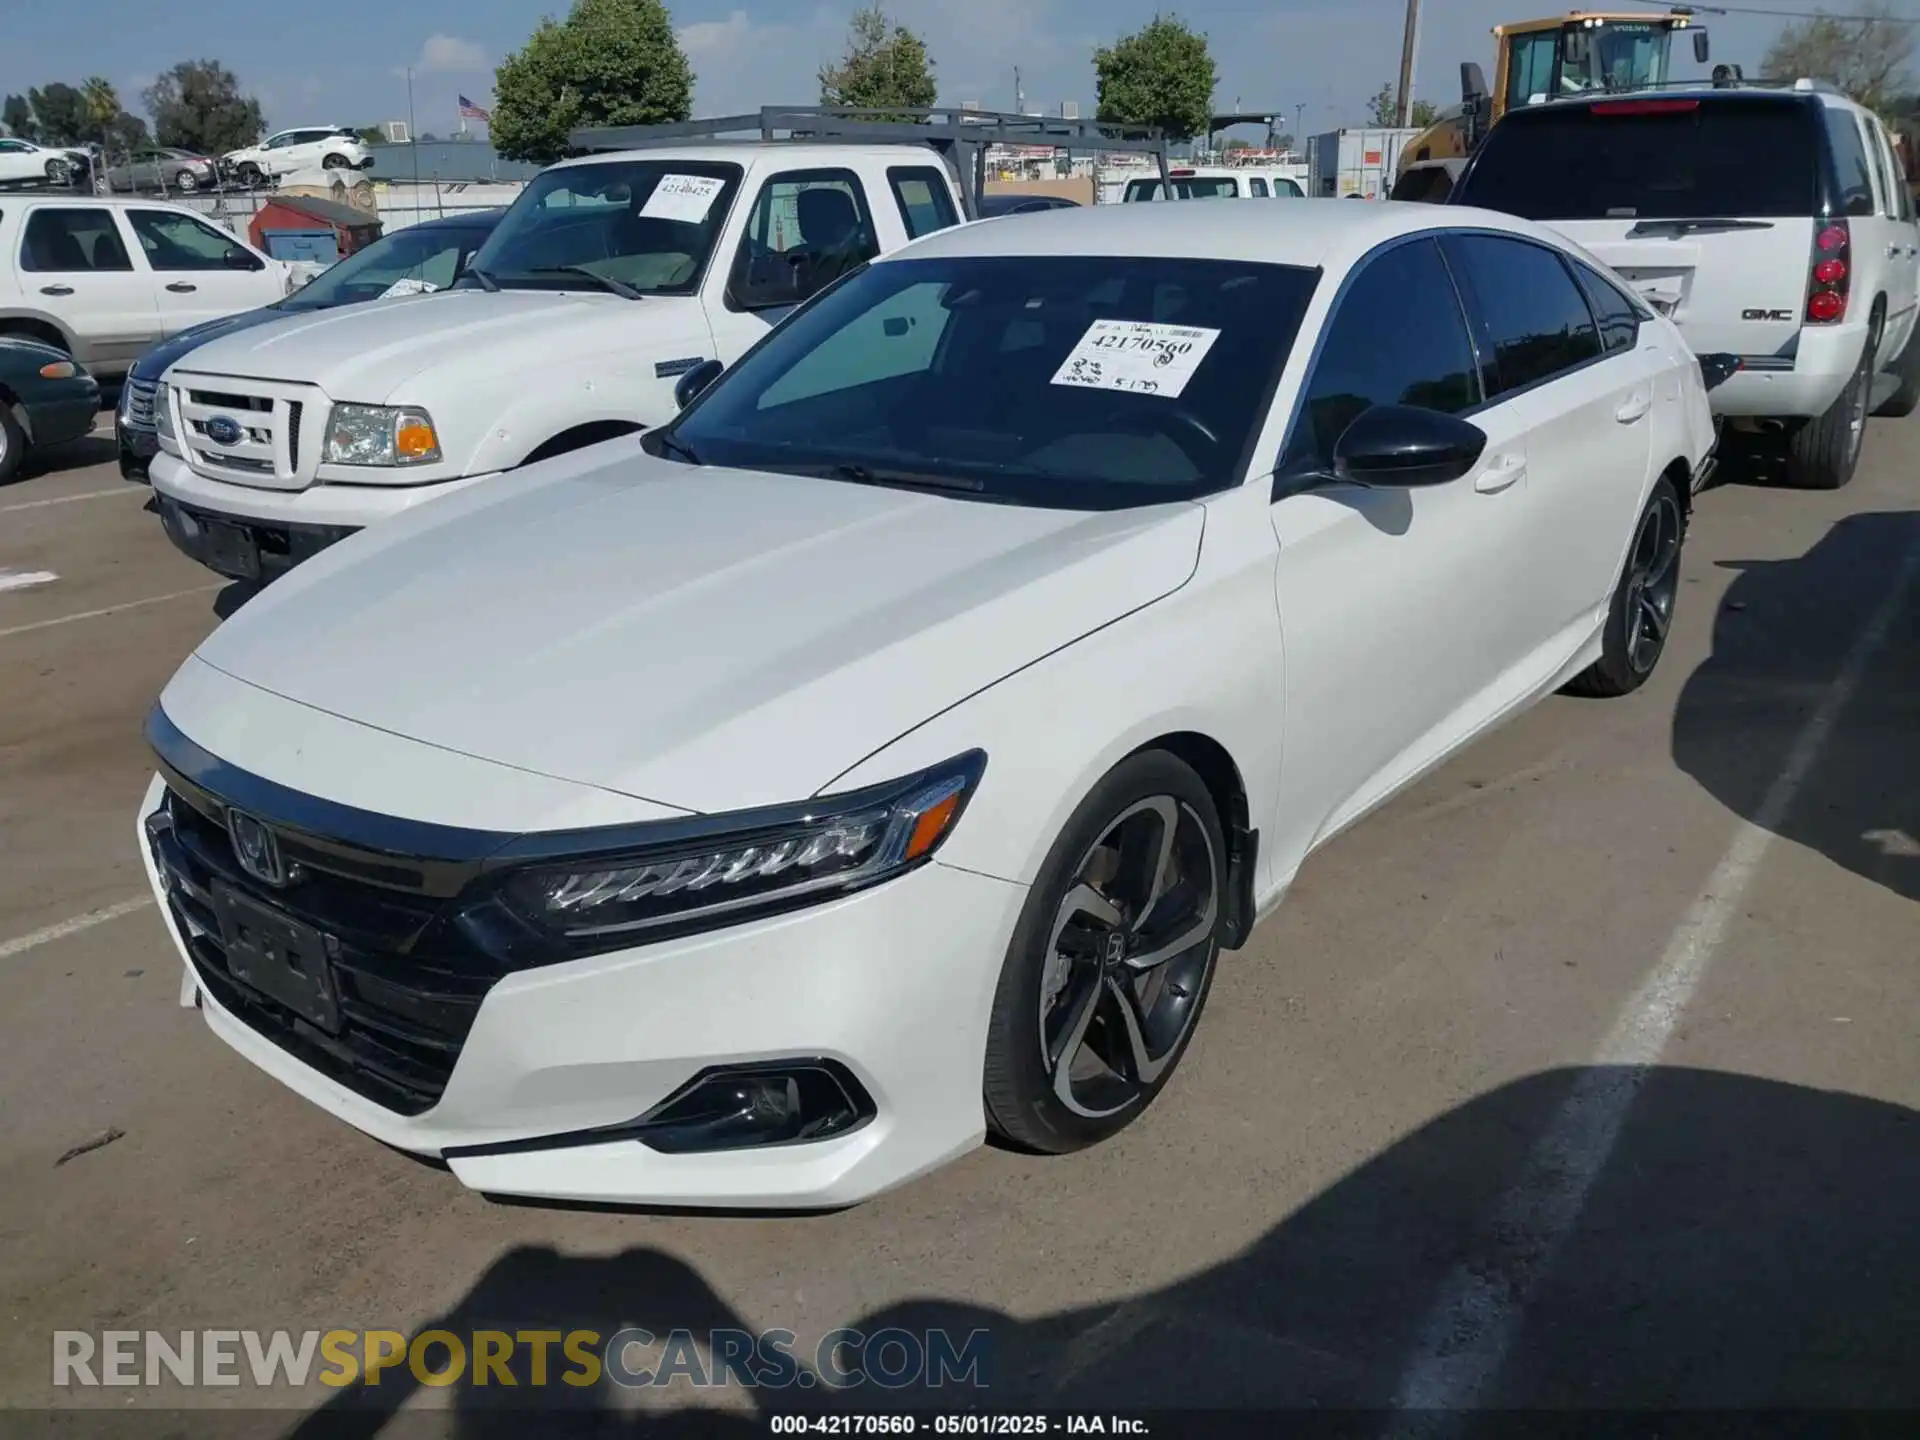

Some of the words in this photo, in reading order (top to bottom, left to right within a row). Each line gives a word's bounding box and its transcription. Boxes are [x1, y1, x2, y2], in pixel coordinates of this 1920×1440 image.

[1612, 24, 1650, 32] VOLVO
[1742, 309, 1792, 320] GMC
[1092, 335, 1193, 355] 42170560
